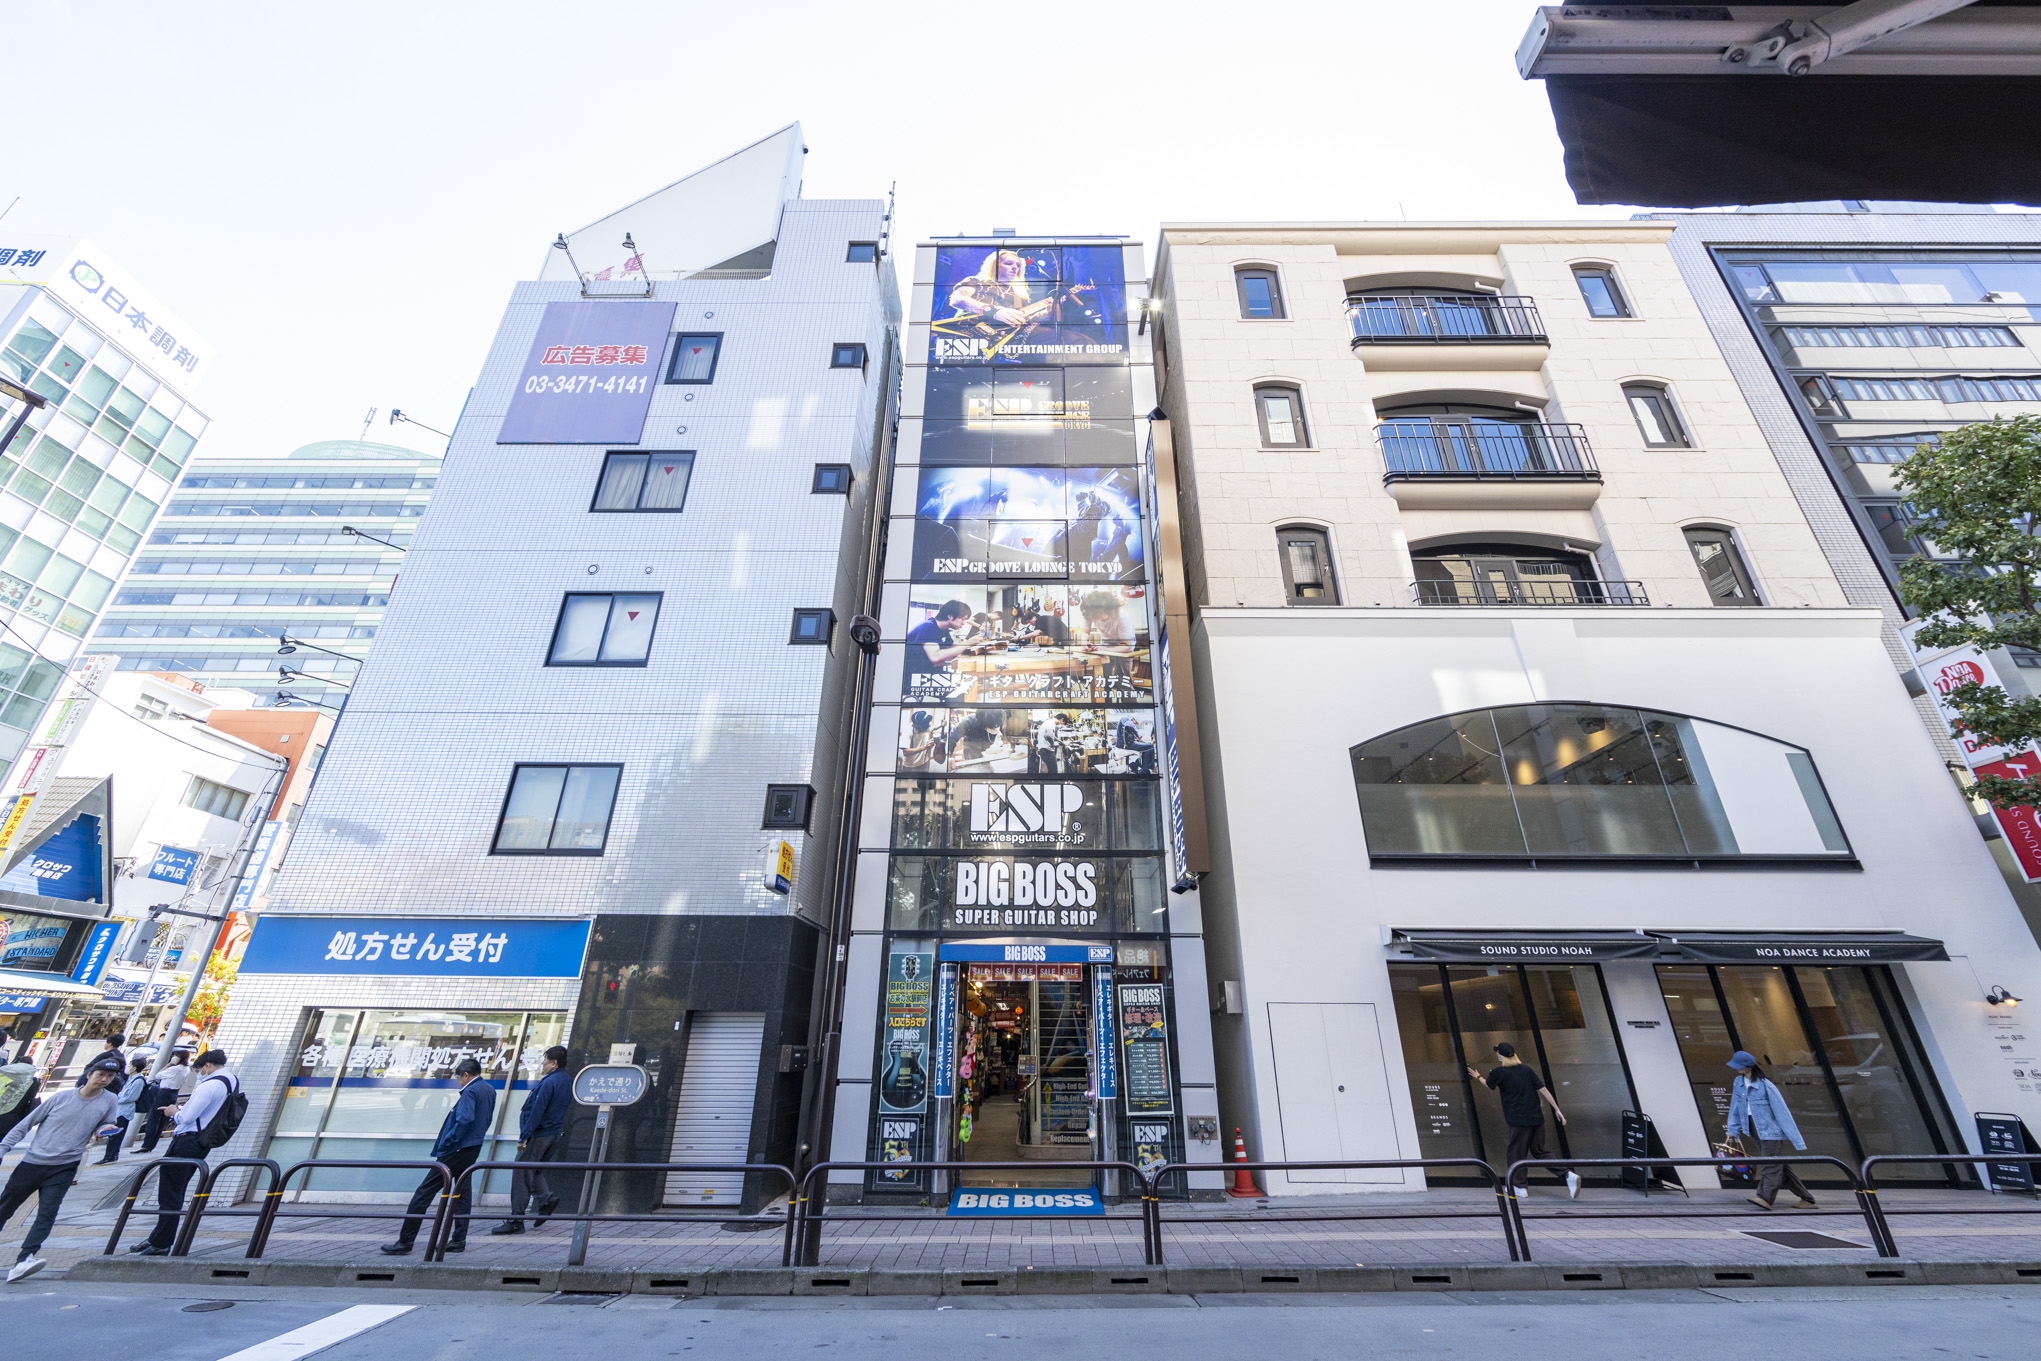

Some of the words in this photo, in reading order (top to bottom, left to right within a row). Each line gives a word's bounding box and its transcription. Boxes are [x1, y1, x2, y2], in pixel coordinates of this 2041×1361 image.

[101, 286, 200, 374] 日本調剤
[935, 338, 988, 356] ESP
[998, 345, 1083, 354] ENTERTAINMENT
[1086, 345, 1123, 354] GROUP
[540, 345, 648, 366] 広告募集
[525, 375, 648, 394] 03-3471-4141
[933, 559, 966, 573] ESP
[968, 562, 1021, 573] GROOVE
[1024, 562, 1075, 573] LOUNGE
[1079, 562, 1123, 573] TOKYO
[1944, 662, 1973, 680] NOA
[911, 674, 974, 687] ESP
[989, 675, 1145, 689] ギタークラフト・アカデミー
[988, 690, 1008, 698] ESP
[1014, 690, 1090, 698] GUITARCRAFT
[1094, 690, 1145, 698] ACADEMY
[970, 783, 1084, 832] ESP
[970, 833, 1085, 844] www.espguitars.co.jp
[32, 859, 73, 873] クロサワ
[156, 851, 194, 868] フルート
[153, 863, 187, 880] 専門店
[956, 861, 1010, 906] BIG
[1013, 862, 1097, 907] BOSS
[955, 909, 999, 925] SUPER
[1004, 909, 1056, 925] GUITAR
[1060, 909, 1098, 925] SHOP
[325, 931, 508, 962] 処方せん受付
[1005, 946, 1020, 961] BIG
[1021, 946, 1046, 961] BOSS
[1091, 948, 1111, 958] ESP
[1480, 946, 1518, 955] SOUND
[1520, 946, 1558, 955] STUDIO
[1561, 946, 1592, 955] NOAH
[1756, 947, 1781, 957] NOA
[1783, 948, 1818, 957] DANCE
[1822, 948, 1871, 958] ACADEMY
[994, 967, 1011, 976] SALE
[1017, 967, 1033, 976] SALE
[1040, 967, 1056, 976] SALE
[1062, 967, 1078, 976] SALE
[890, 982, 905, 991] BIG
[906, 982, 929, 991] BOSS
[1123, 989, 1137, 1003] BIG
[1138, 988, 1161, 1003] BOSS
[888, 1016, 927, 1028] 入口こちらです
[588, 1077, 632, 1087] かえで通り
[883, 1121, 917, 1138] ESP
[1134, 1125, 1168, 1143] ESP
[957, 1194, 1010, 1208] BIG
[1014, 1194, 1094, 1207] BOSS
